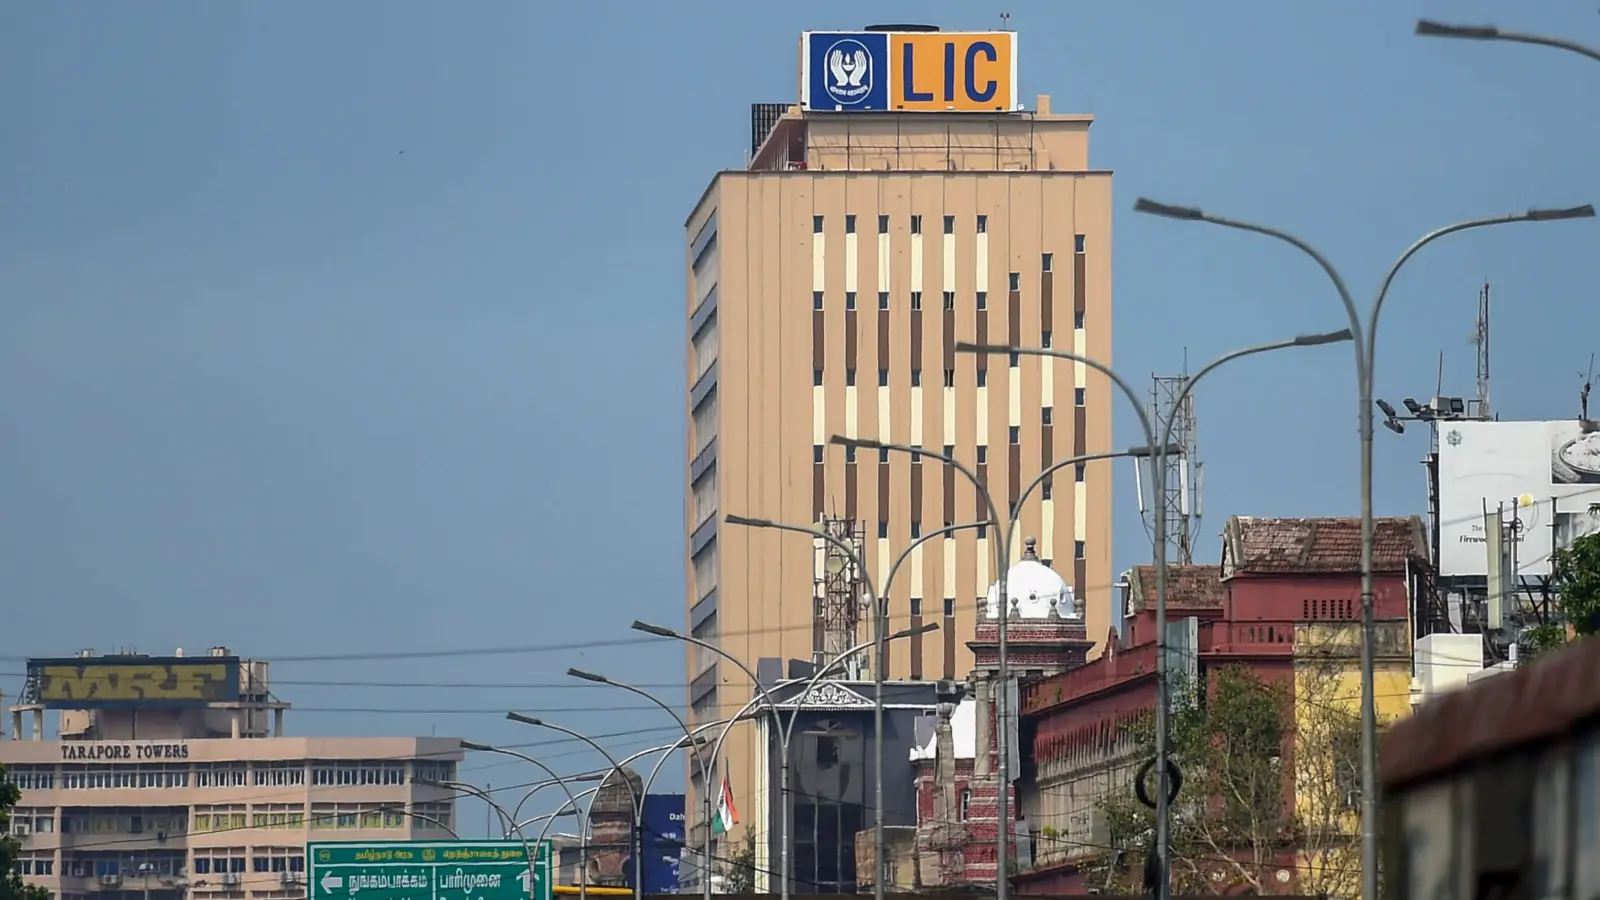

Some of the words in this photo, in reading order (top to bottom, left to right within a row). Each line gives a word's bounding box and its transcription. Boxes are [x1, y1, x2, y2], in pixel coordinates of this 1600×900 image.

[903, 42, 997, 102] LIC
[42, 664, 226, 700] MRF
[61, 745, 131, 760] TARAPORE
[136, 744, 188, 759] TOWERS
[349, 869, 428, 896] நுங்கம்பாக்கம்
